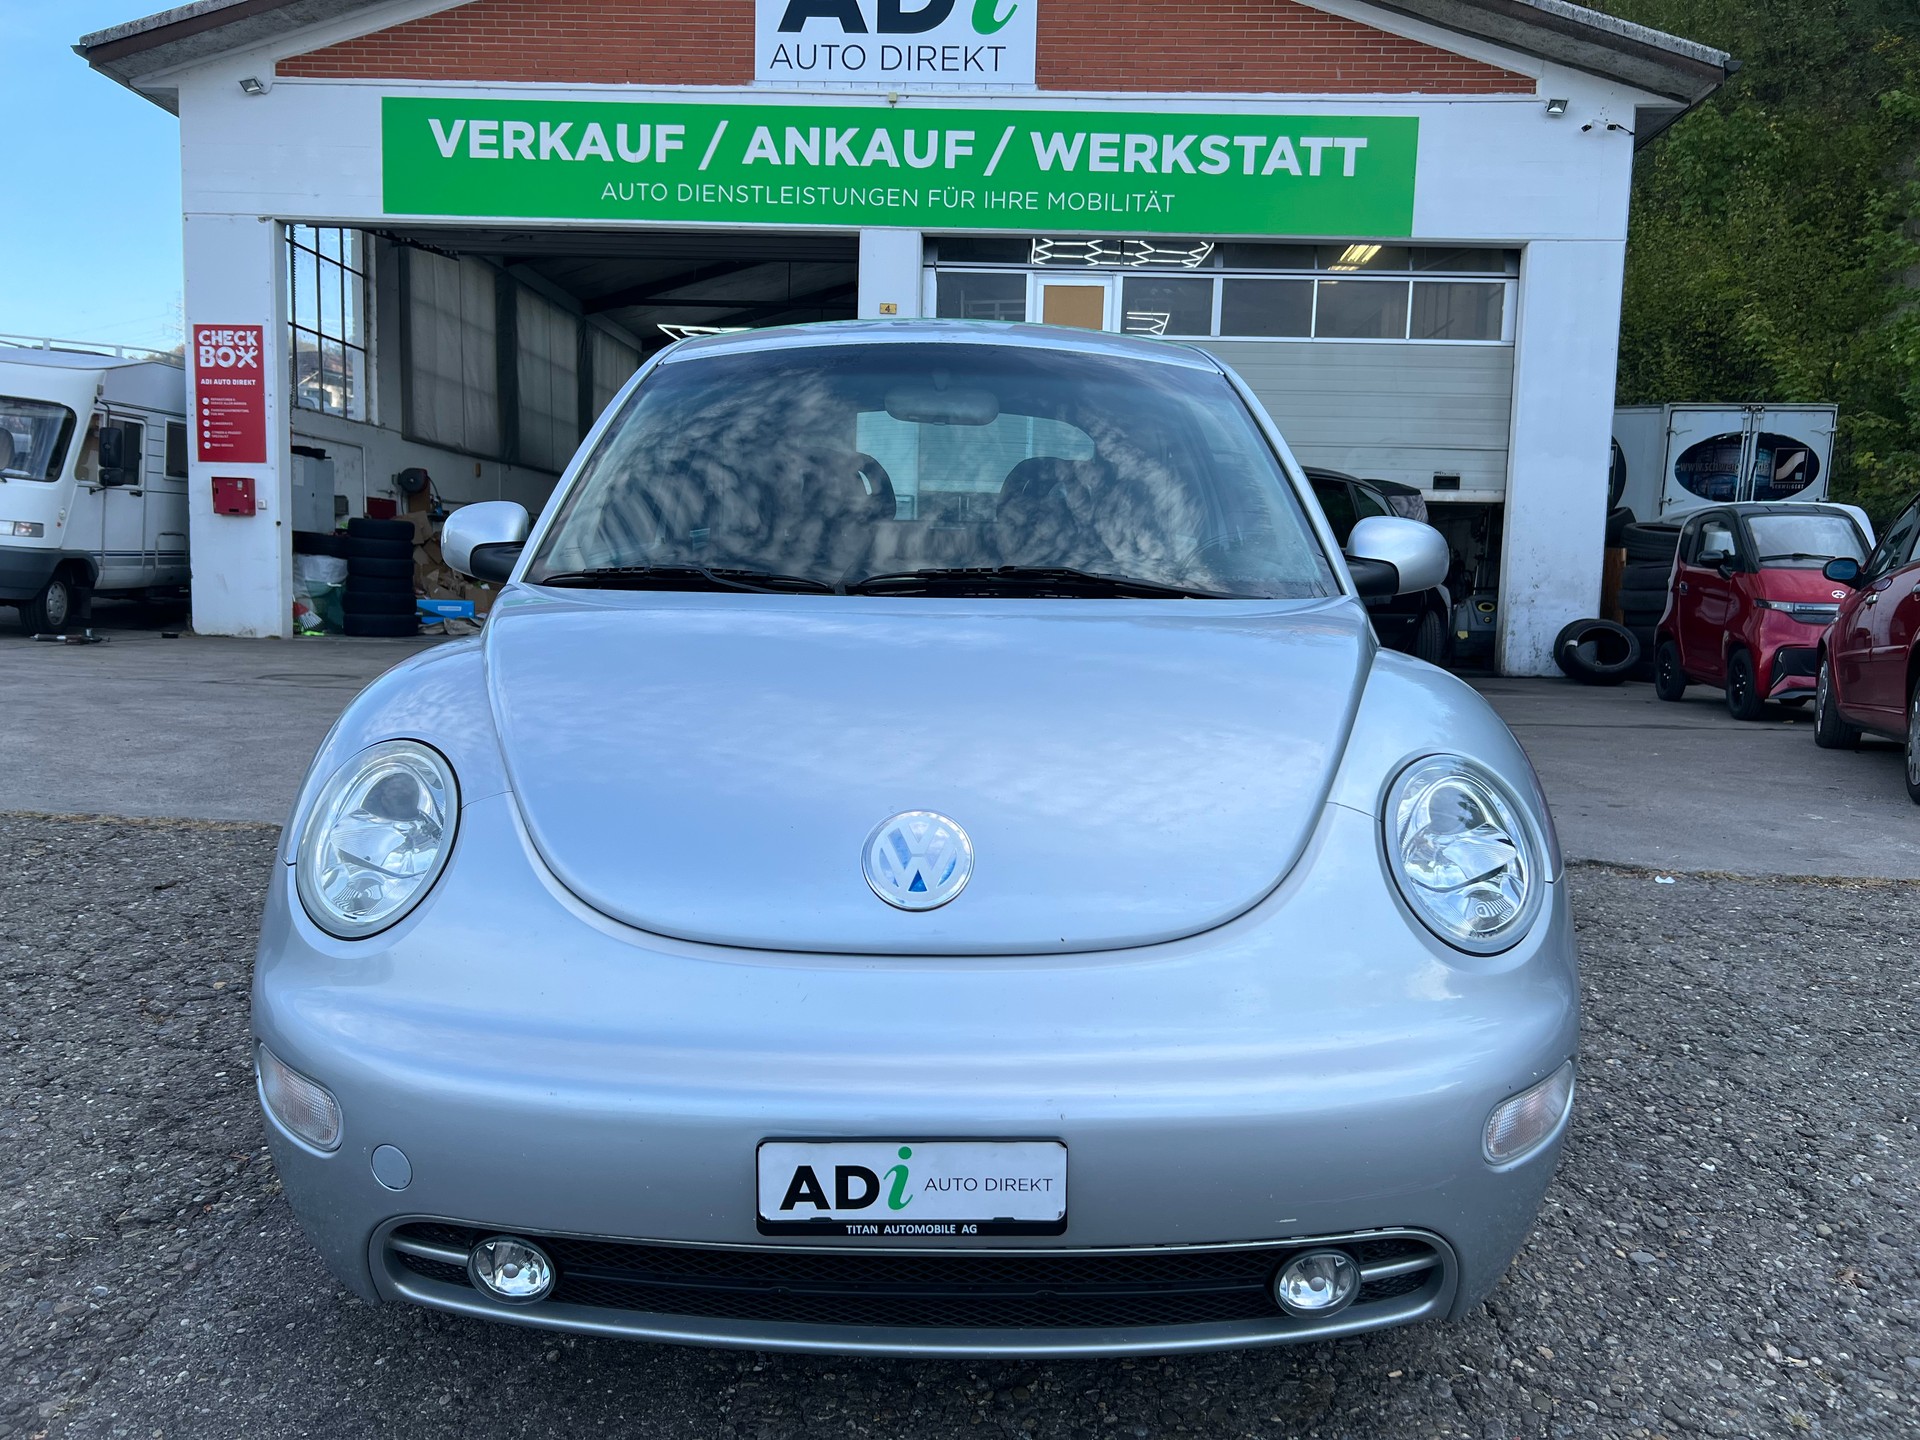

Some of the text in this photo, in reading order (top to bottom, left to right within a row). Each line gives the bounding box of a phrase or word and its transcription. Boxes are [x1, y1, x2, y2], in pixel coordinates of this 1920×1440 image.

[769, 43, 1007, 73] AUTO DIREKT
[427, 117, 1369, 178] VERKAUF / ANKAUF / WERKSTATT
[601, 181, 1176, 214] AUTO DIENSTLEISTUNGEN FÜR IHRE MOBILITÄT
[198, 329, 259, 347] CHECK
[213, 378, 232, 386] AUTO
[779, 1146, 1054, 1211] ADi AUTO DIREKT
[846, 1224, 978, 1235] TITAN AUTOMOBILE AG
